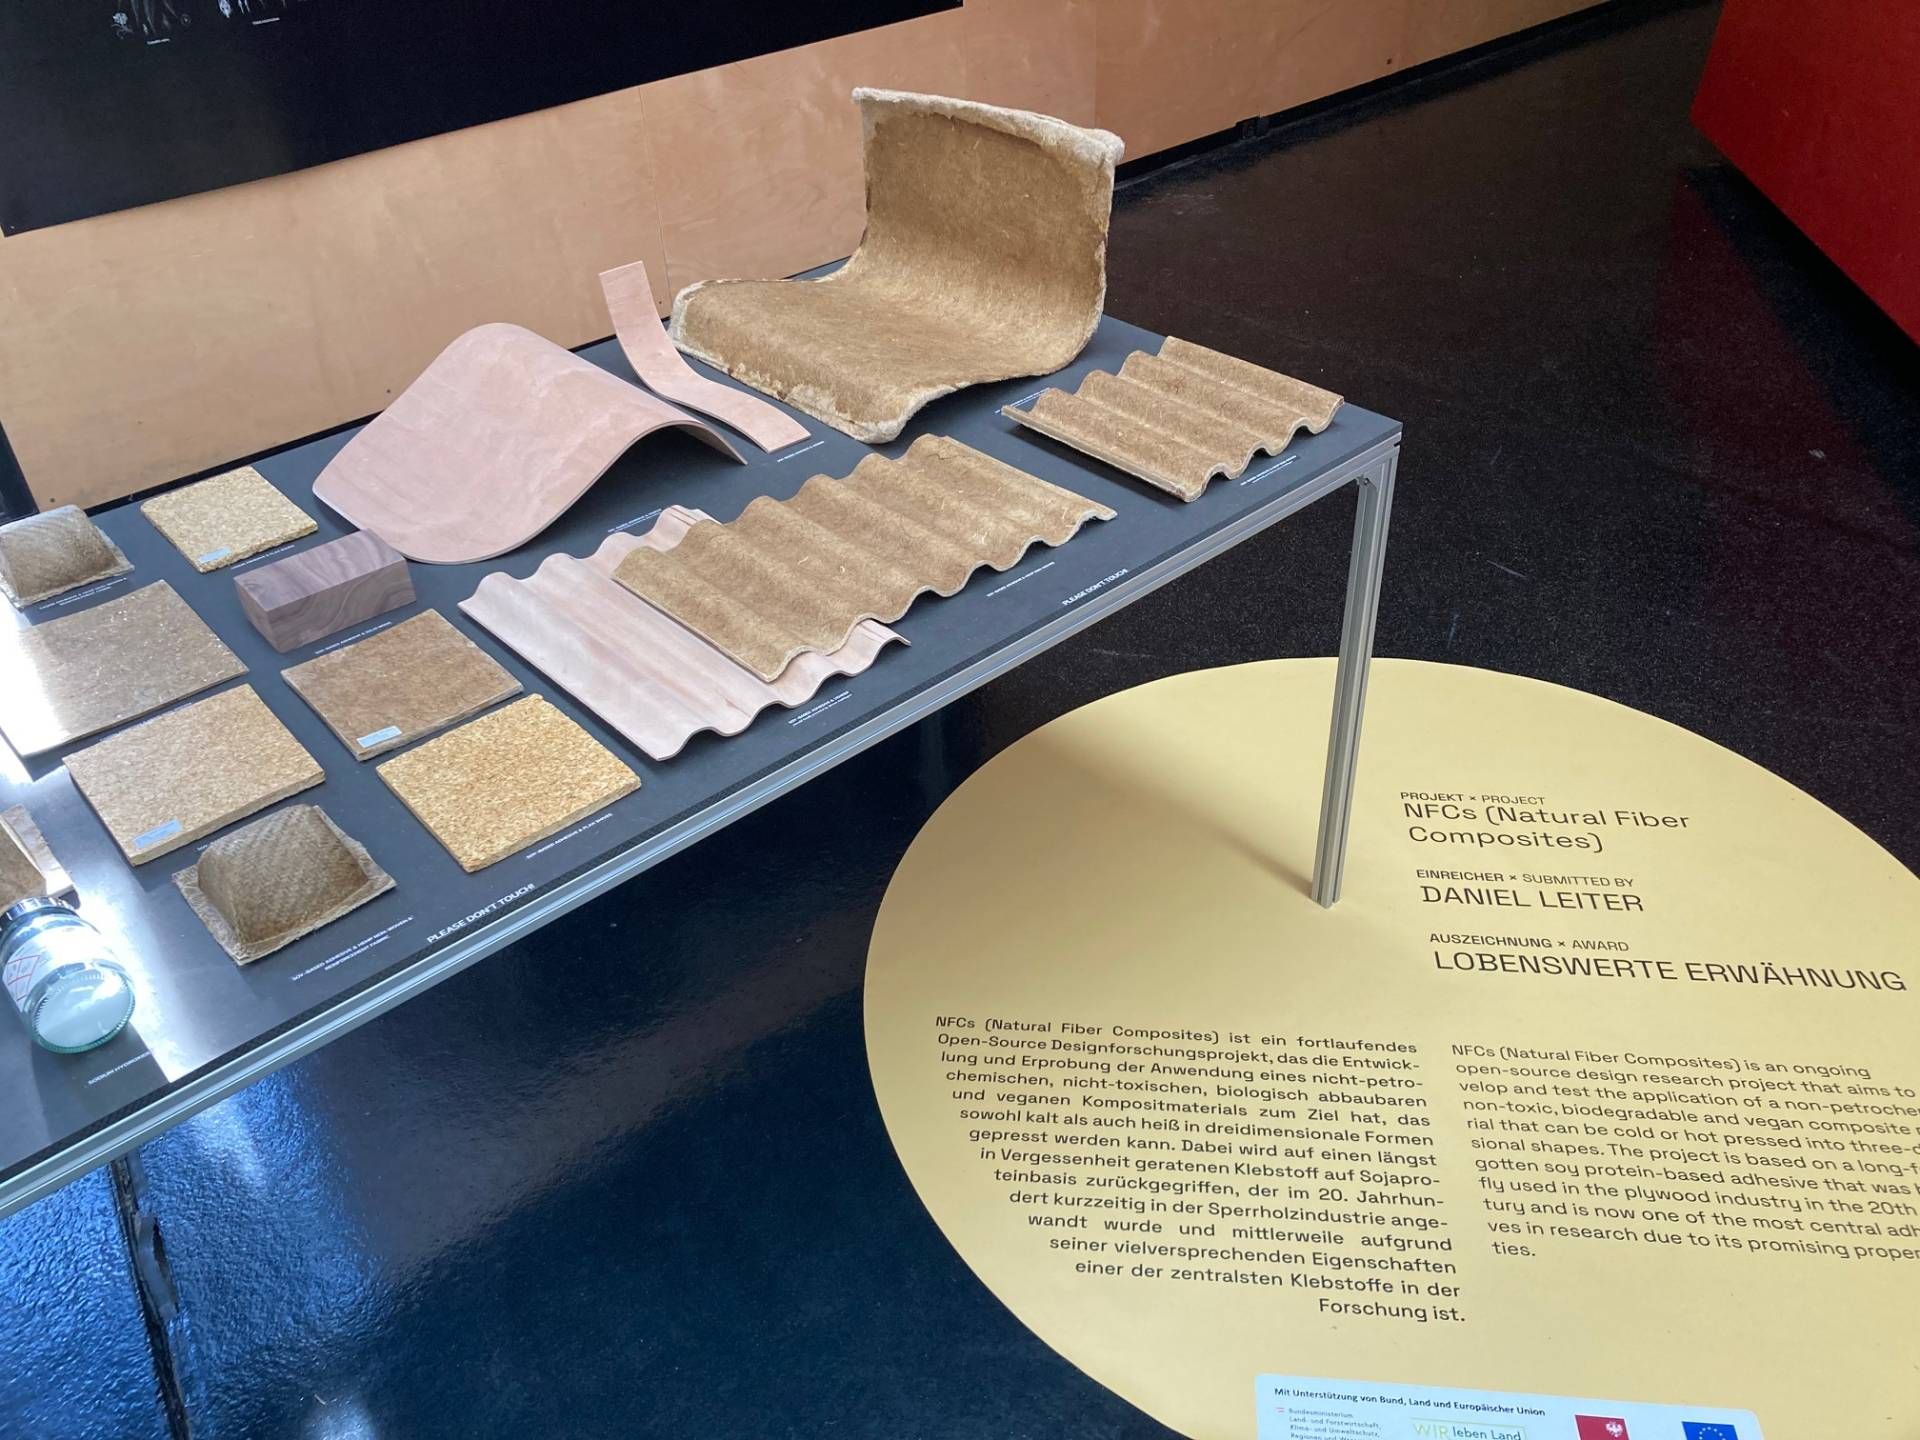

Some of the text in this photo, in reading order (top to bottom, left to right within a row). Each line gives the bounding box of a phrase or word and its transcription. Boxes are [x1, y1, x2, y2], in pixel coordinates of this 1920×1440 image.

[1062, 591, 1087, 606] PLEASE
[1400, 791, 1545, 806] PROJEKT PROJECT
[1403, 802, 1690, 828] NFCs (Natural Fiber
[1408, 826, 1603, 854] Composites)
[1416, 869, 1634, 887] EINREICHER SUBMITTED BY
[426, 883, 535, 943] PLEASE DON'T TOUCH!
[1419, 885, 1644, 912] DANIEL LEITER
[1429, 933, 1629, 952] AUSZEICHNUNG AWARD
[1434, 950, 1907, 991] LOBENSWERTE ERWÄHNUNG
[935, 1016, 1417, 1054] NFCs (Natural Fiber Composites) ist ein fortlaufendes
[938, 1033, 1420, 1071] Open-Source Designforschungsprojekt, das die Entwick-
[941, 1050, 1423, 1089] lung und Erprobung der Anwendung eines nicht-petro-
[1451, 1044, 1872, 1080] NFCs (Natural Fiber Composites) is an ongoing
[1456, 1064, 1916, 1098] open-source design research project that aims to
[946, 1069, 1427, 1107] chemischen, nicht-toxischen, biologisch abbaubaren
[952, 1089, 1431, 1127] und veganen Kompositmaterials zum Ziel hat, das
[960, 1109, 1434, 1146] sowohl kalt als auch heiß in dreidimensionale Formen
[969, 1129, 1437, 1168] gepresst werden kann. Dabei wird auf einen längst
[980, 1147, 1440, 1188] in Vergessenheit geratenen Klebstoff auf Sojapro-
[993, 1168, 1444, 1208] teinbasis zurückgegriffen, der im 20. Jahrhun-
[1478, 1176, 1918, 1216] fly used in the plywood industry in the 20th
[1009, 1189, 1448, 1231] dert kurzzeitig in der Sperrholzindustrie ange-
[1028, 1214, 1453, 1252] wandt wurde und mittlerweile aufgrund
[1487, 1222, 1521, 1234] ves
[1525, 1221, 1544, 1236] in
[1549, 1226, 1639, 1242] research
[1643, 1229, 1682, 1245] due
[1686, 1232, 1711, 1247] to
[1714, 1233, 1743, 1249] its
[1747, 1239, 1851, 1259] promising
[1049, 1236, 1457, 1275] seiner vielversprechenden Eigenschaften
[1075, 1260, 1460, 1298] einer der zentralsten Klebstoffe in der
[1319, 1298, 1466, 1323] Forschung ist.
[1274, 1388, 1546, 1416] Mit Unterstützung von Bund, Land und Europäischer Union
[1452, 1426, 1487, 1440] leben
[1491, 1429, 1521, 1440] Land
